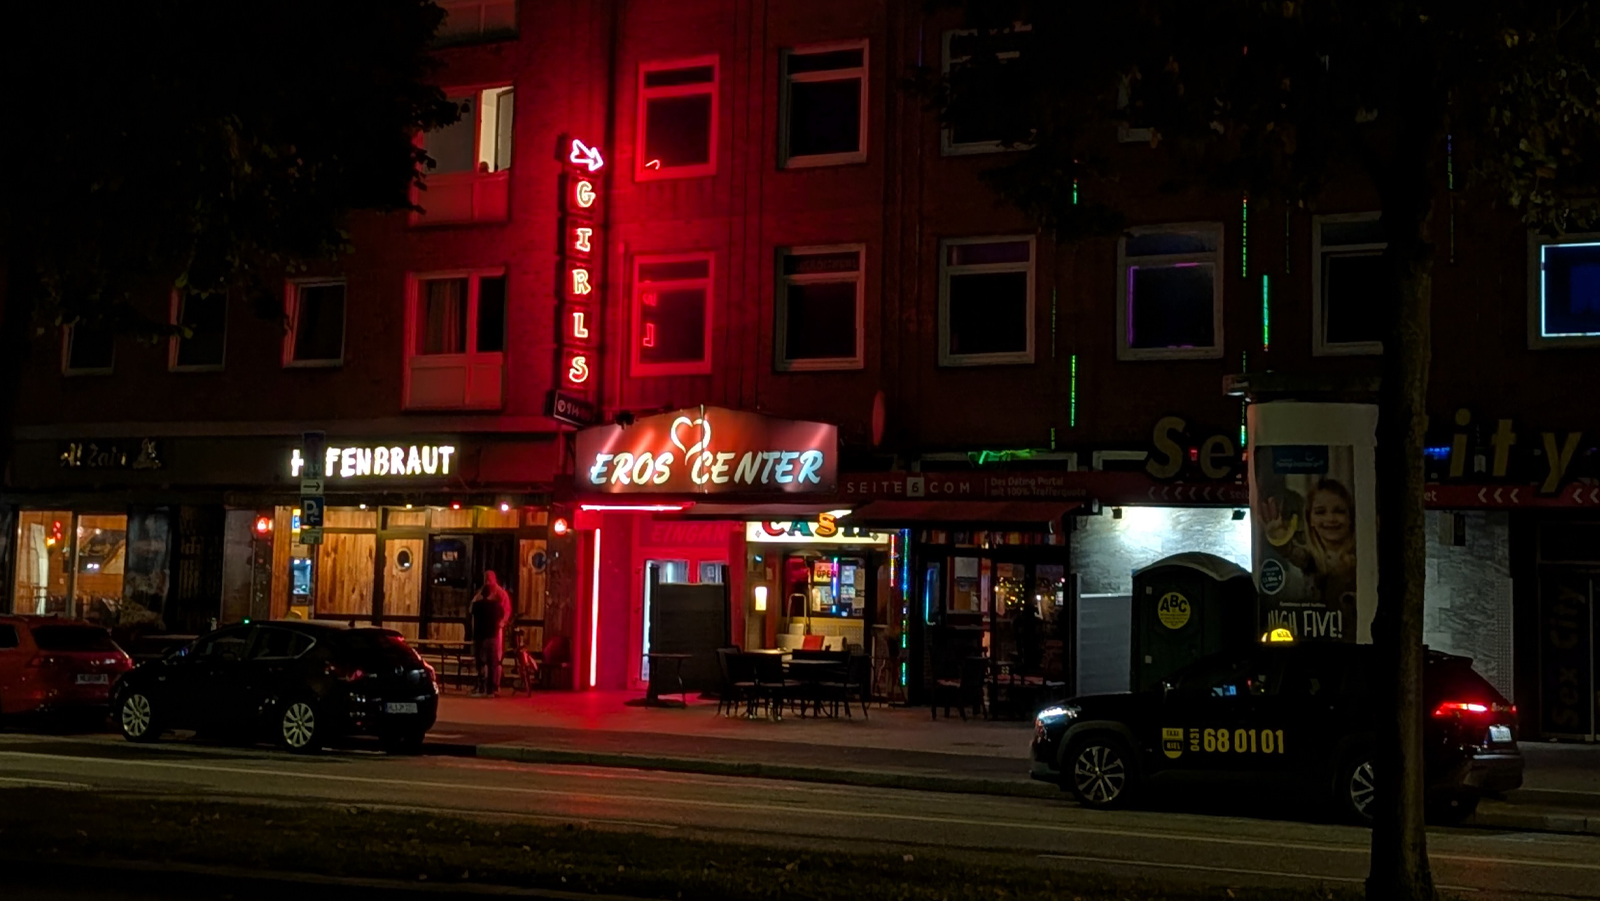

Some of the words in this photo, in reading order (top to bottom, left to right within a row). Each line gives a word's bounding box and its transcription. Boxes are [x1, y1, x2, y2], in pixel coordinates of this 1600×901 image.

[569, 180, 596, 383] GIRLS
[290, 445, 455, 478] HFENBRAUT
[1145, 416, 1235, 479] Se
[1449, 407, 1583, 493] ity
[590, 452, 674, 485] EROS
[690, 450, 824, 485] CENTER
[846, 481, 903, 494] SEITE
[929, 481, 970, 494] COM
[652, 523, 729, 544] EINGAN
[1160, 594, 1188, 612] ABC
[1549, 584, 1587, 650] City
[1303, 608, 1343, 639] FIVE!
[1550, 665, 1580, 730] Sex
[1203, 728, 1230, 753] 68
